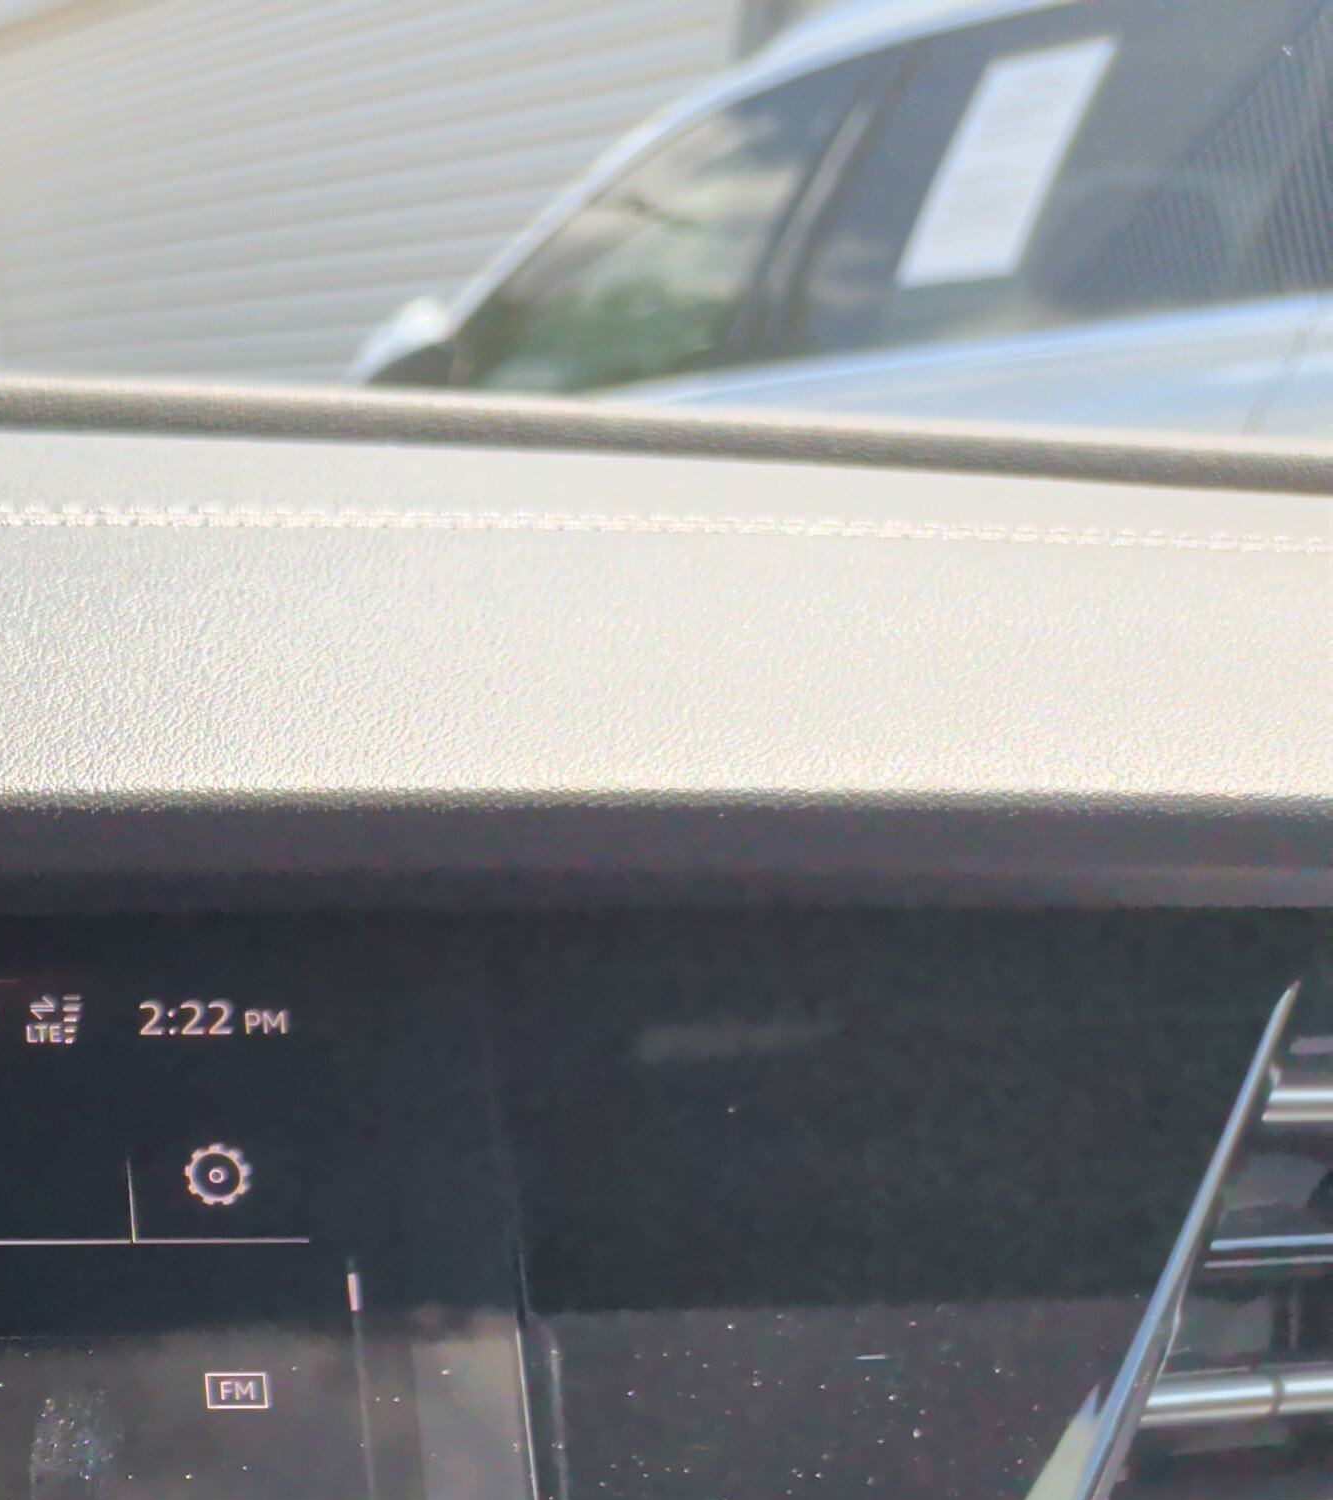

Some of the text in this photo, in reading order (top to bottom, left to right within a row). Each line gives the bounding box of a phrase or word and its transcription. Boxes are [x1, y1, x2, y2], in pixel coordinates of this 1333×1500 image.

[139, 1001, 288, 1037] 2:22 PM
[25, 1023, 62, 1044] LTE
[220, 1380, 256, 1401] FM
